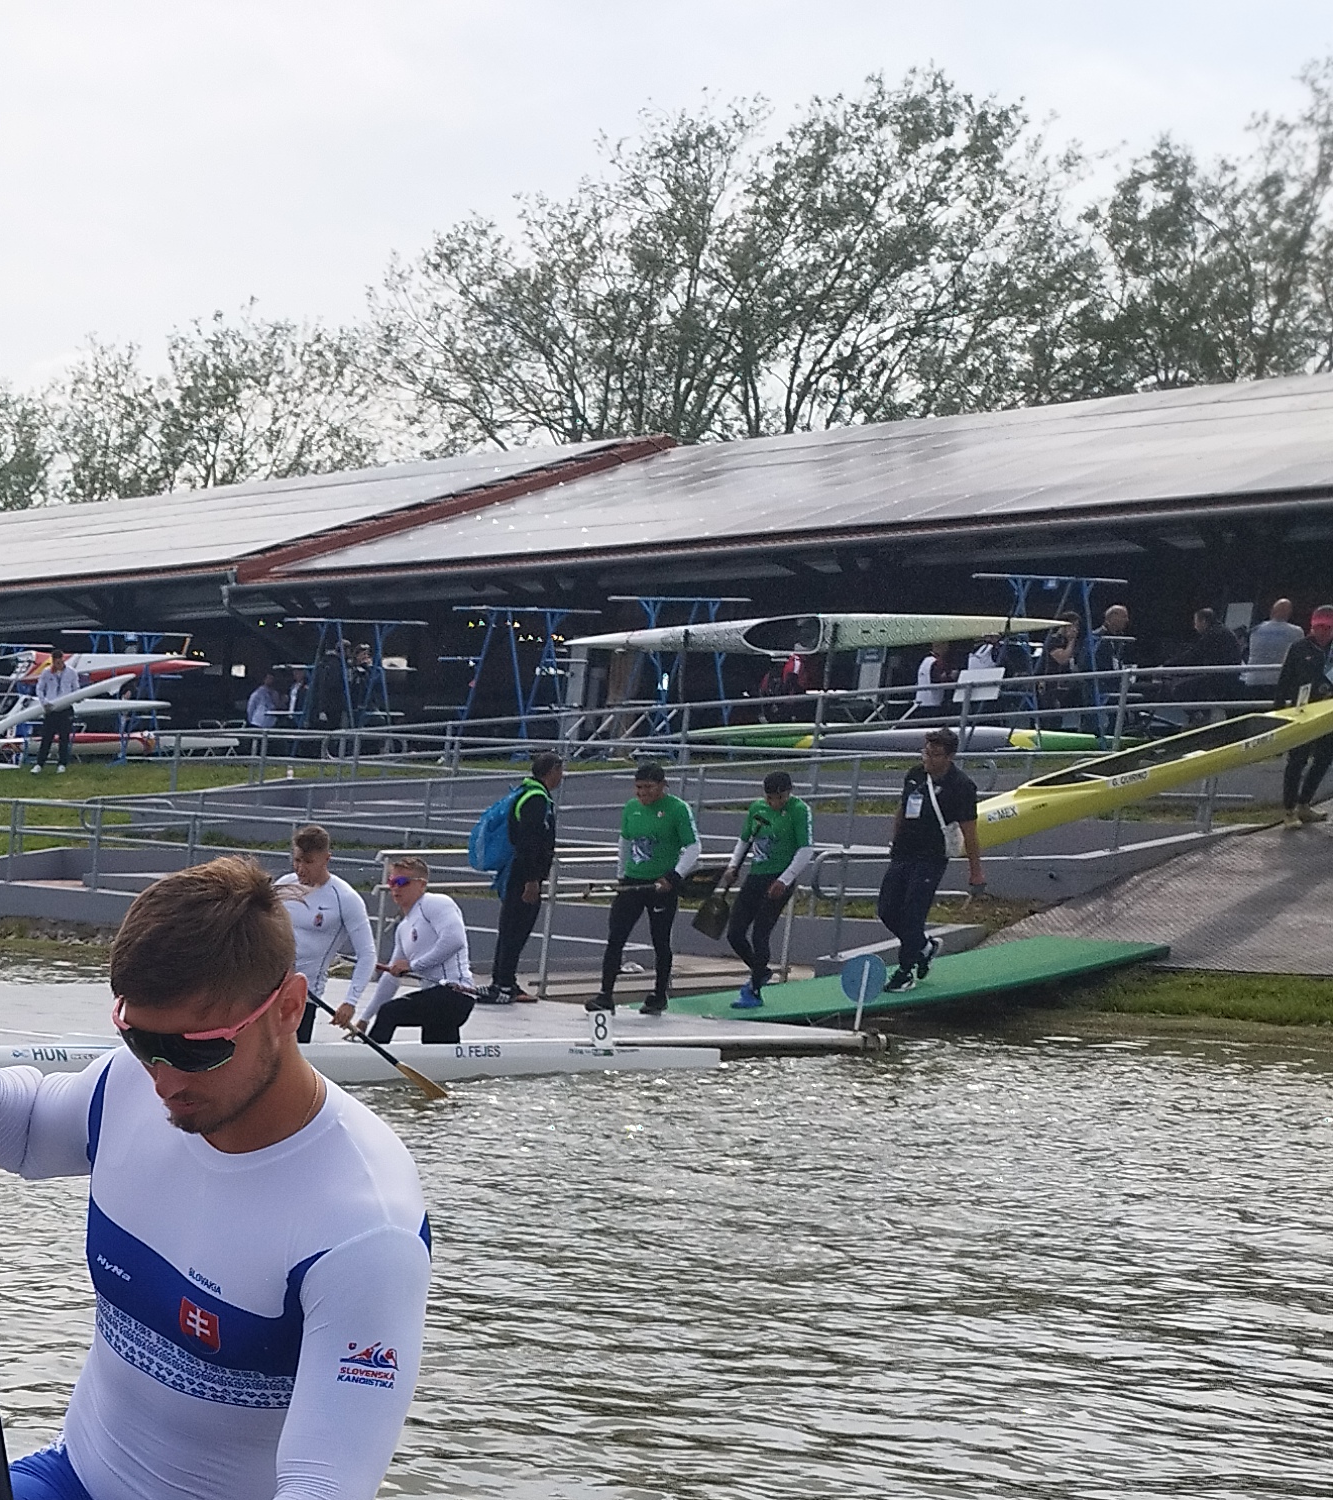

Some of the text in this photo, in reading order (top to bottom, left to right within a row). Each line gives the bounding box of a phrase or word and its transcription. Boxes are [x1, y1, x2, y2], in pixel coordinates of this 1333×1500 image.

[998, 805, 1018, 820] MEX
[594, 1013, 607, 1040] 8
[33, 1049, 68, 1062] HUN
[456, 1046, 501, 1058] D. FEJES
[188, 1267, 222, 1295] SLOVAKIA
